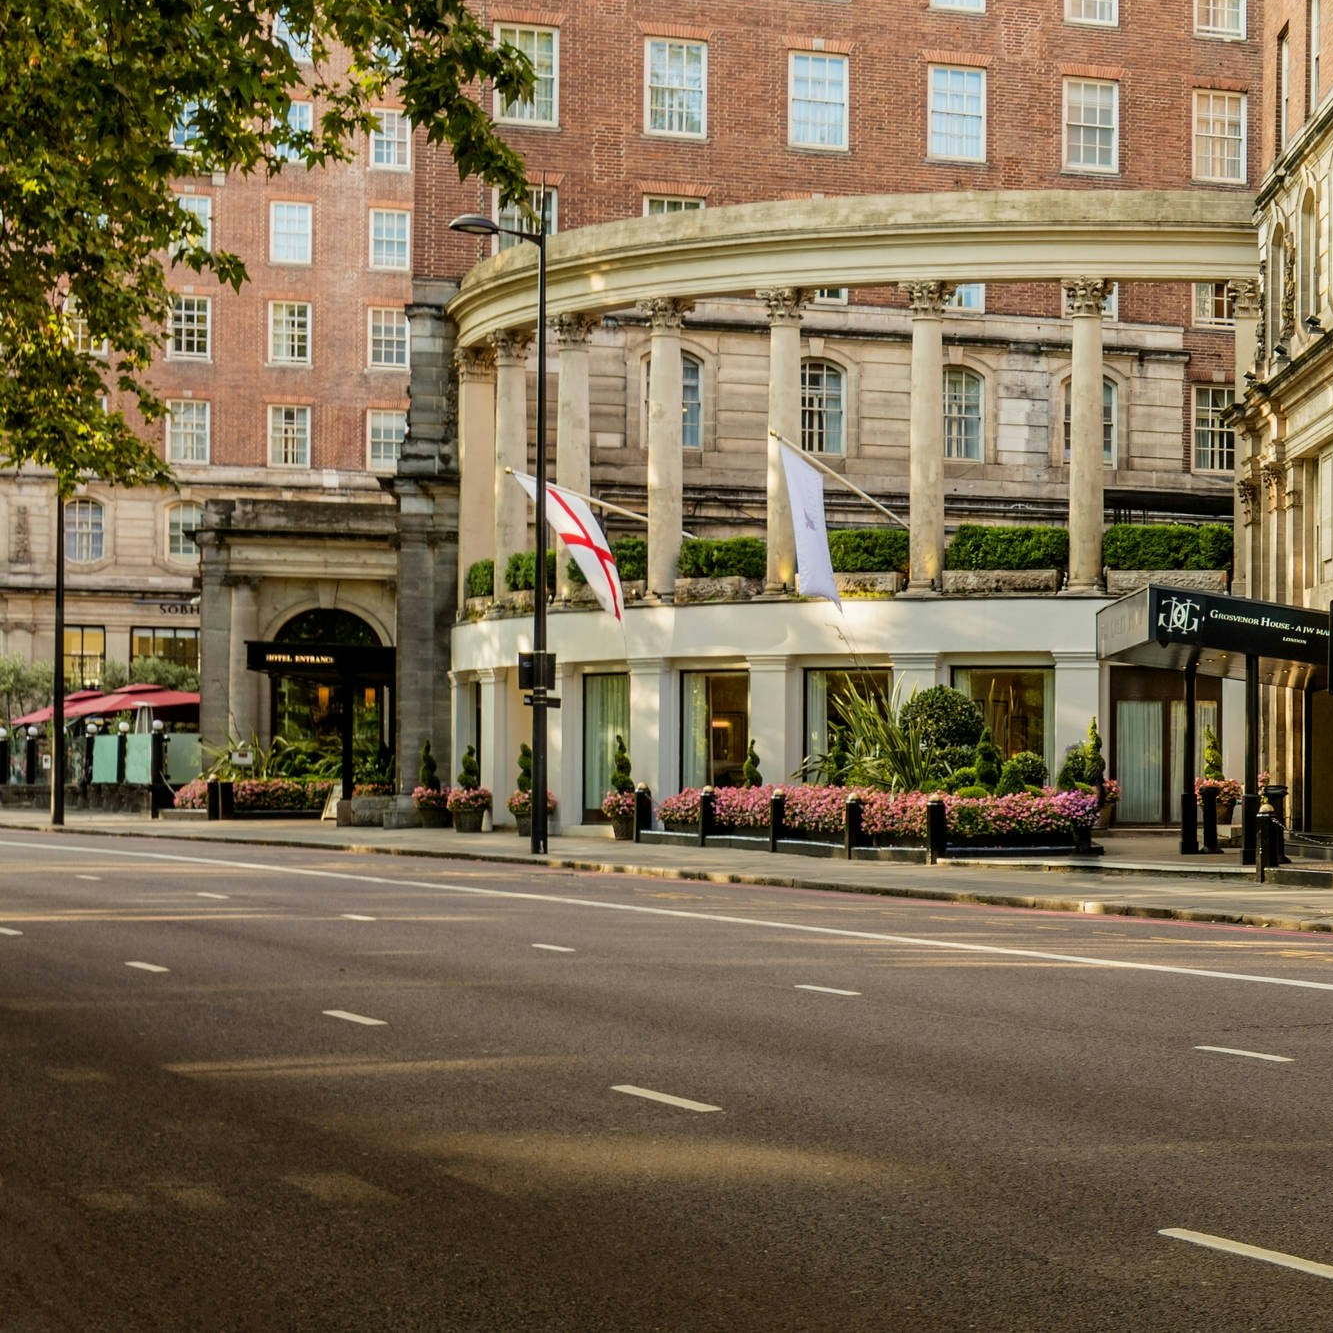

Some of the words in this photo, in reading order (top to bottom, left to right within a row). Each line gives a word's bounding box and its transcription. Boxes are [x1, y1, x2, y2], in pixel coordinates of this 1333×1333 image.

[1209, 609, 1260, 626] GROSVENOR
[1260, 617, 1291, 631] HOUSE
[1302, 626, 1315, 634] JW
[1282, 636, 1307, 645] LONDON
[265, 653, 293, 663] HOTEL
